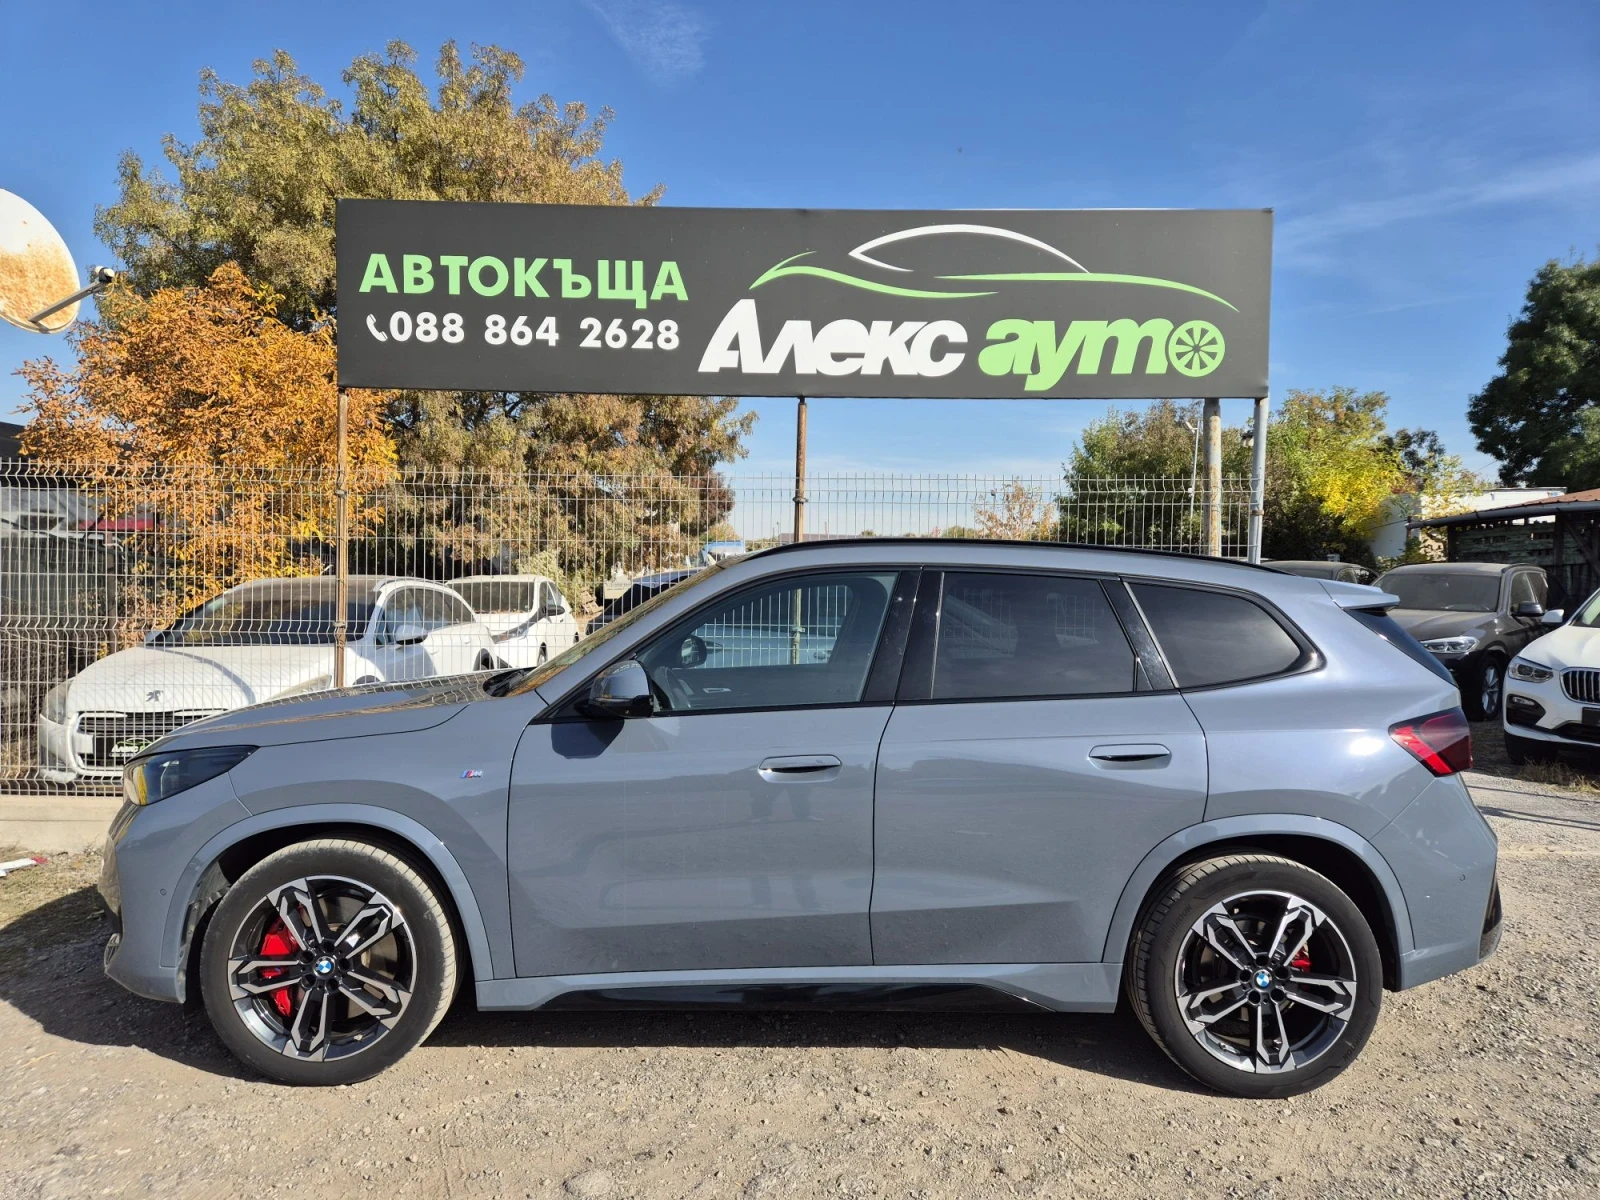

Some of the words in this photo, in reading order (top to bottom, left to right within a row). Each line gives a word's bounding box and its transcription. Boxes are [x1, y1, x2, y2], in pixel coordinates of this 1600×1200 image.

[359, 253, 689, 309] АВТОКЪЩА
[389, 311, 465, 344] 088
[484, 313, 560, 347] 864
[579, 316, 681, 352] 2628
[697, 298, 968, 378] Алекс
